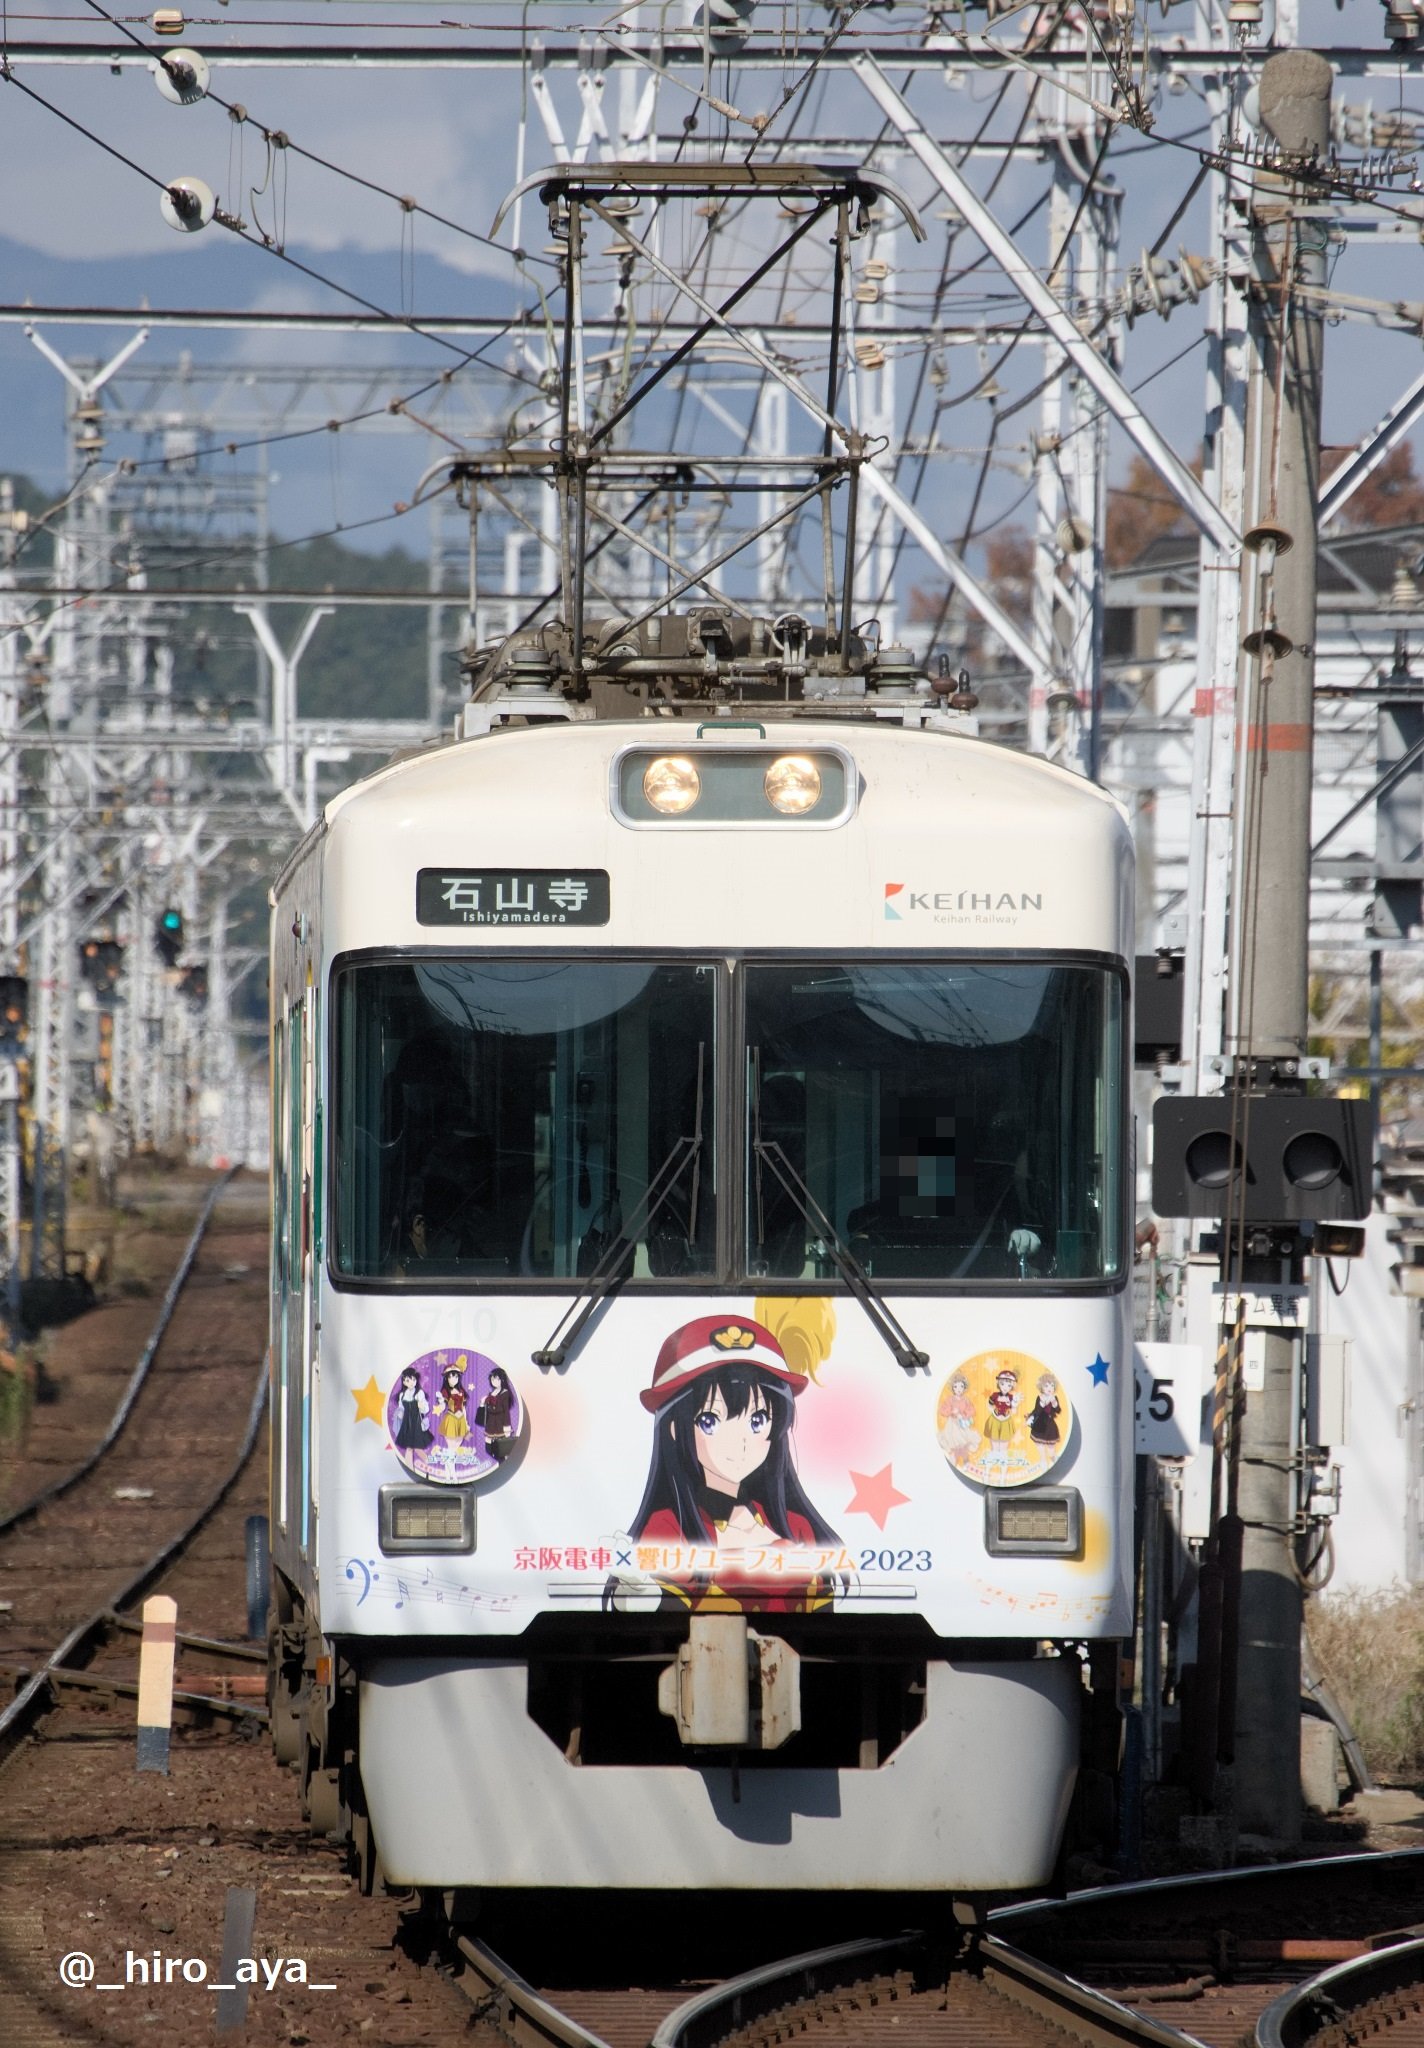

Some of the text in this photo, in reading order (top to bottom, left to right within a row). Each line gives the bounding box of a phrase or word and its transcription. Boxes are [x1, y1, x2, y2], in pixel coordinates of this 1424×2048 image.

[441, 877, 589, 911] 石山寺
[463, 911, 566, 924] Ishiyamadera
[933, 914, 1018, 927] Keihan Railway
